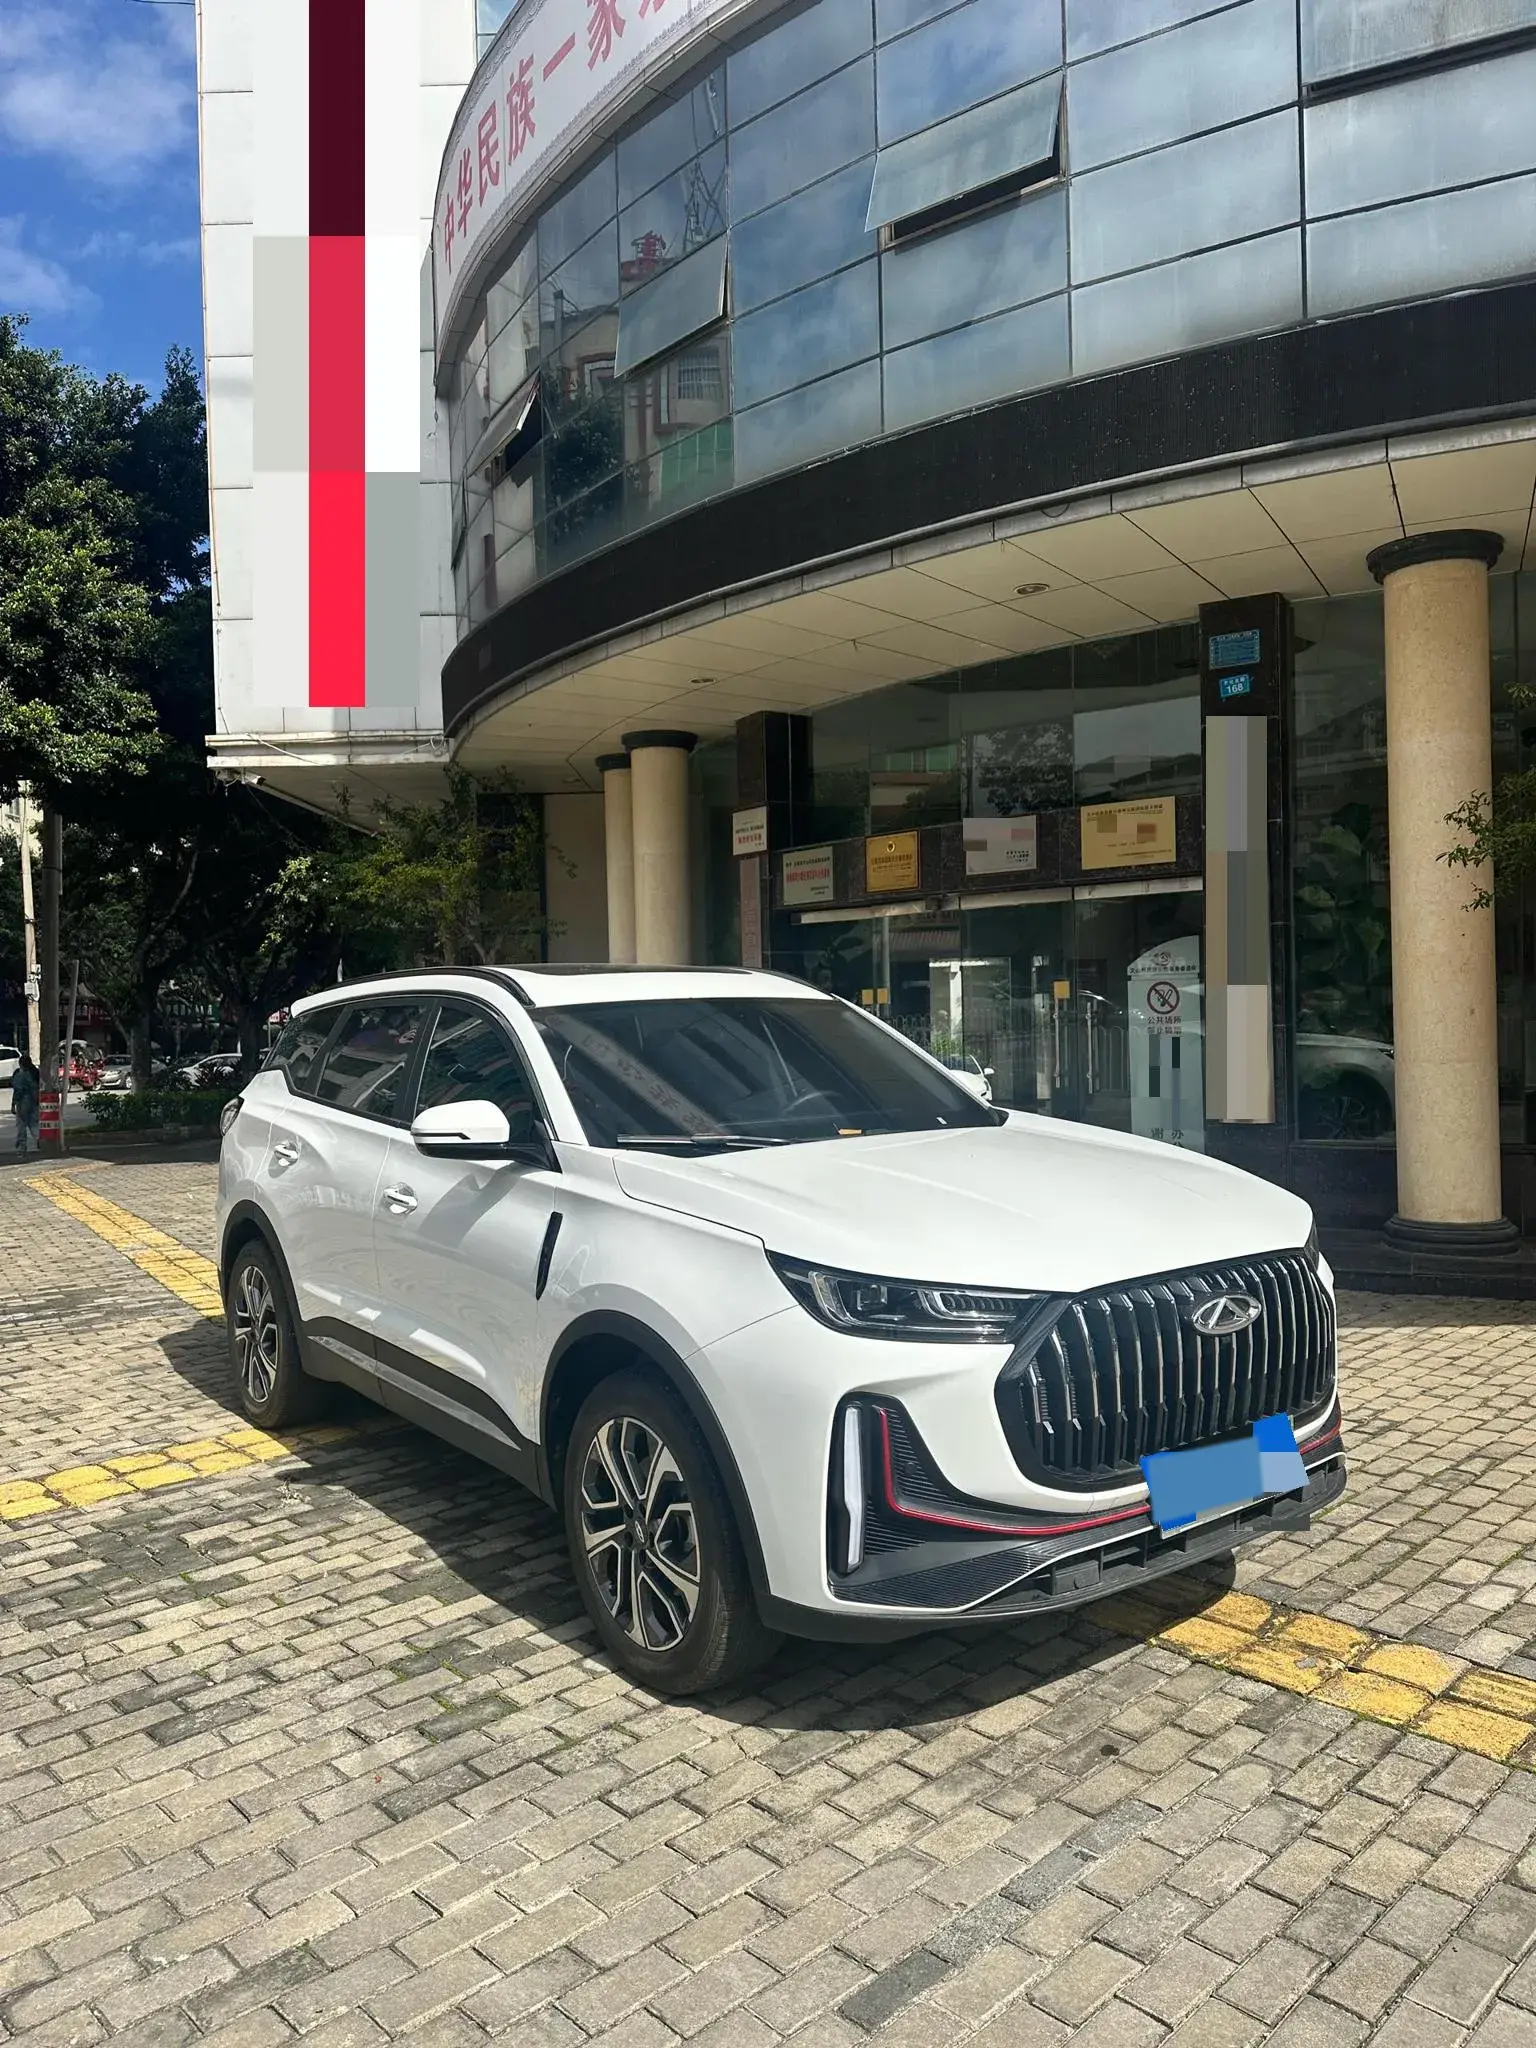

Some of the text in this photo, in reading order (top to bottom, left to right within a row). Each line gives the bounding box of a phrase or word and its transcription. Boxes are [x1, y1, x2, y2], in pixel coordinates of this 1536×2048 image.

[444, 0, 667, 274] 中华民族一家
[1226, 682, 1244, 694] 168
